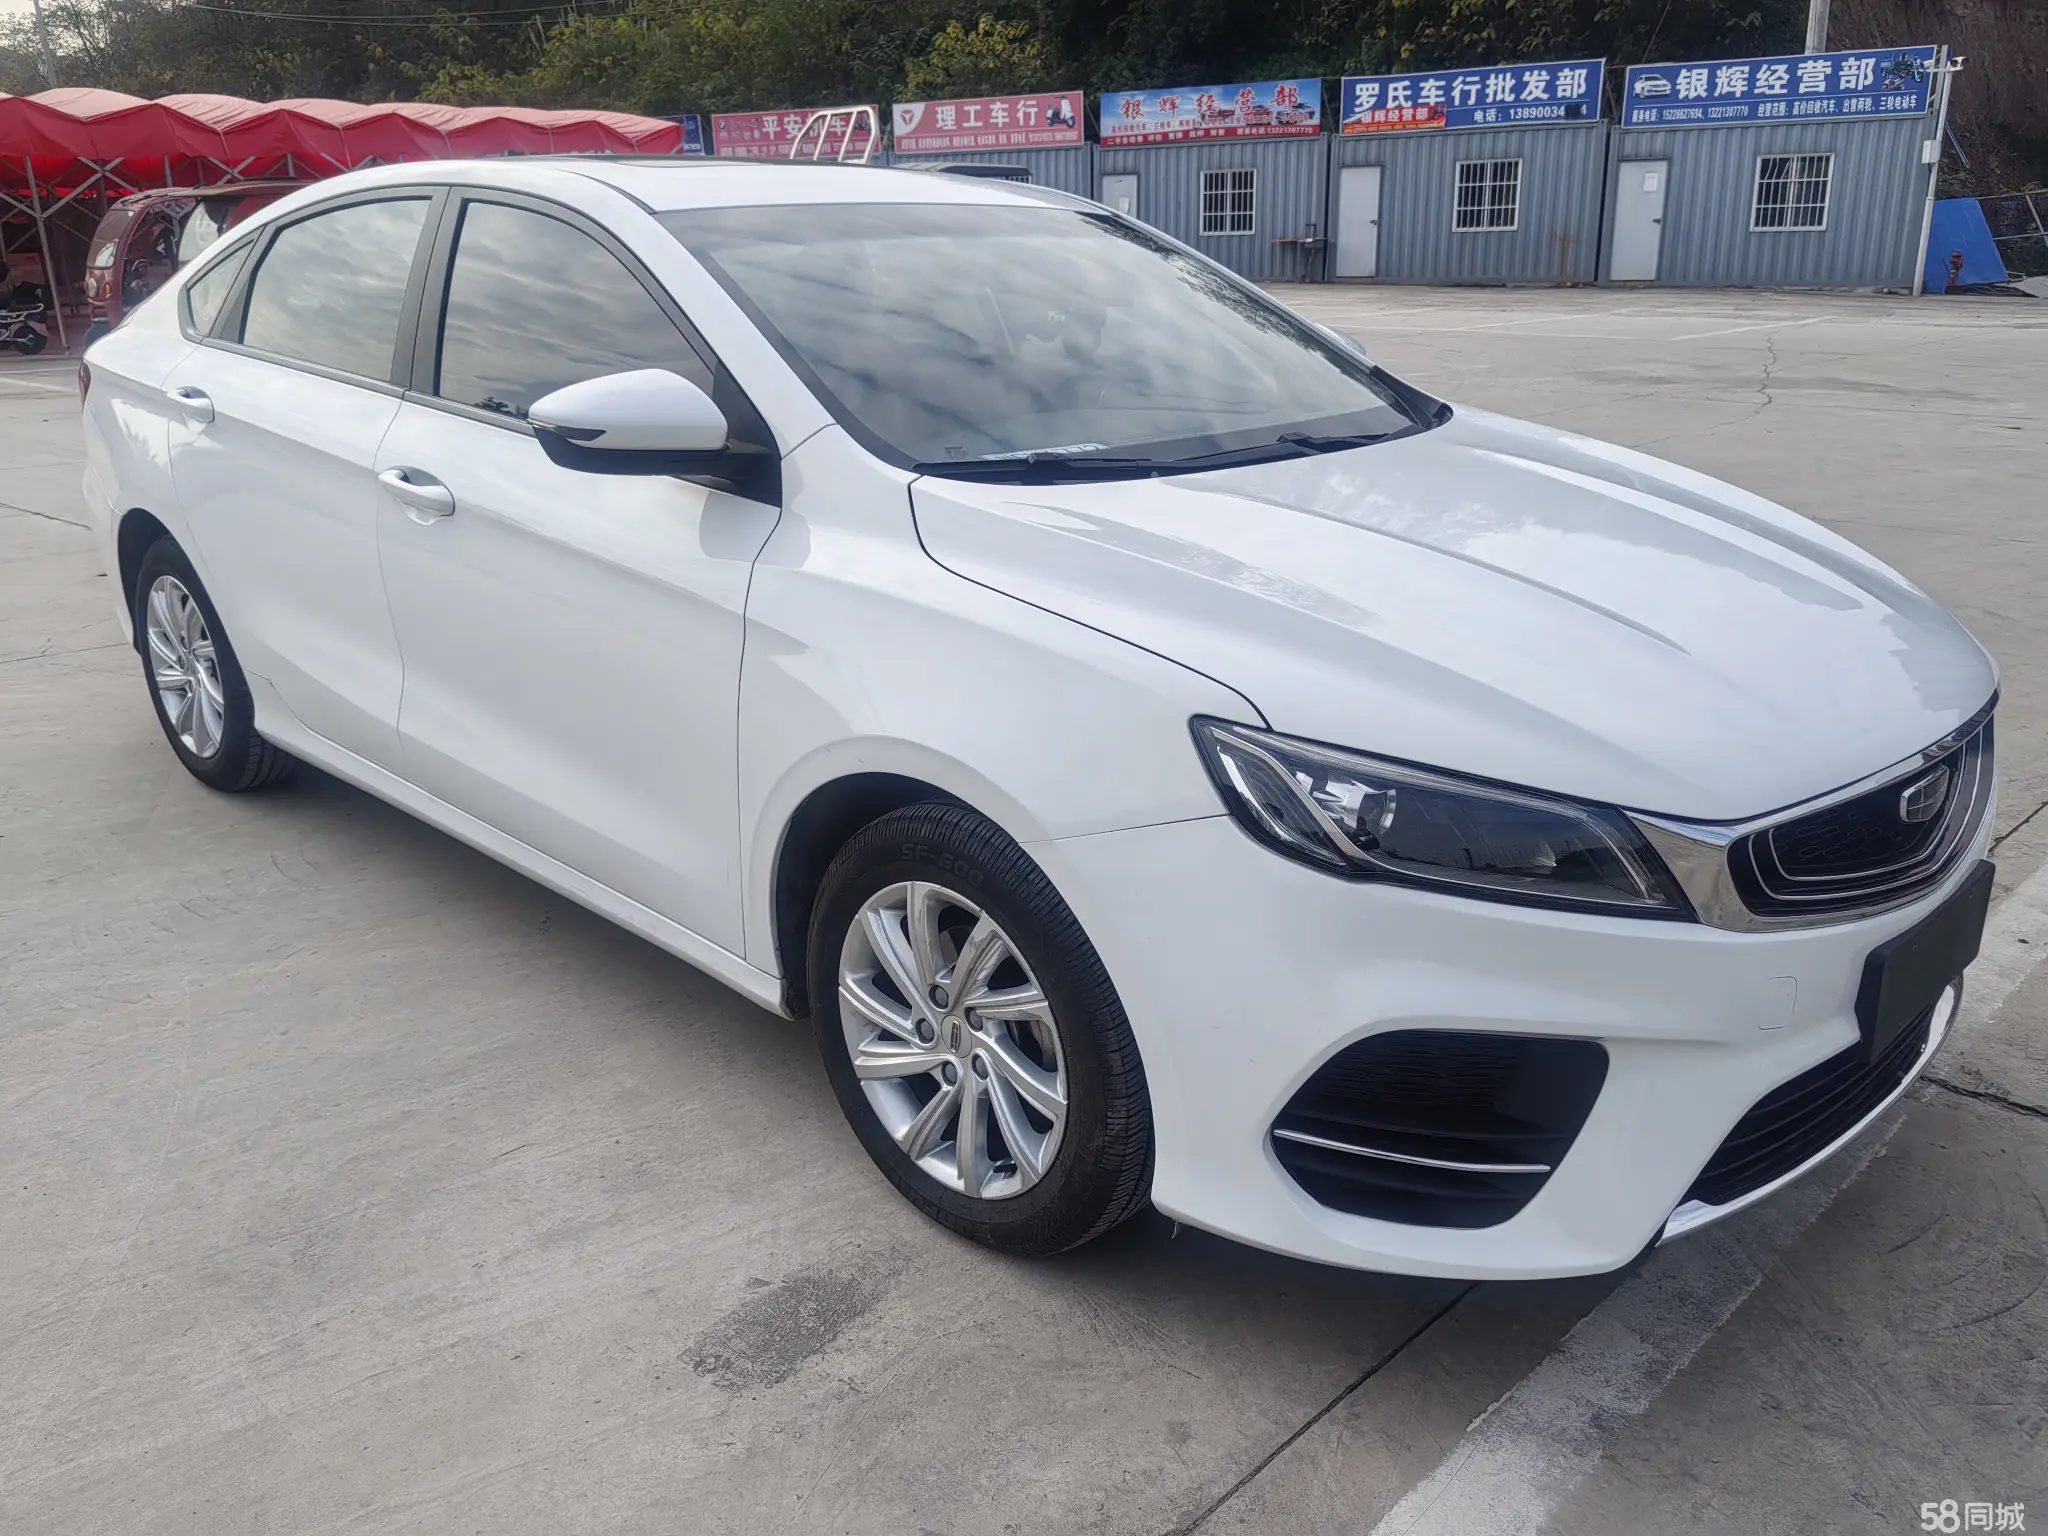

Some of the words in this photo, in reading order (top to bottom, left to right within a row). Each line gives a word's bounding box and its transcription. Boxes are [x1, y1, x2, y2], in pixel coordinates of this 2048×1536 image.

[1354, 68, 1588, 113] 罗氏车行批发部
[1675, 57, 1876, 99] 银辉经营部
[1119, 84, 1299, 120] 银辉经营部
[1473, 103, 1587, 123] 电话：138900344
[901, 843, 984, 888] SF-600
